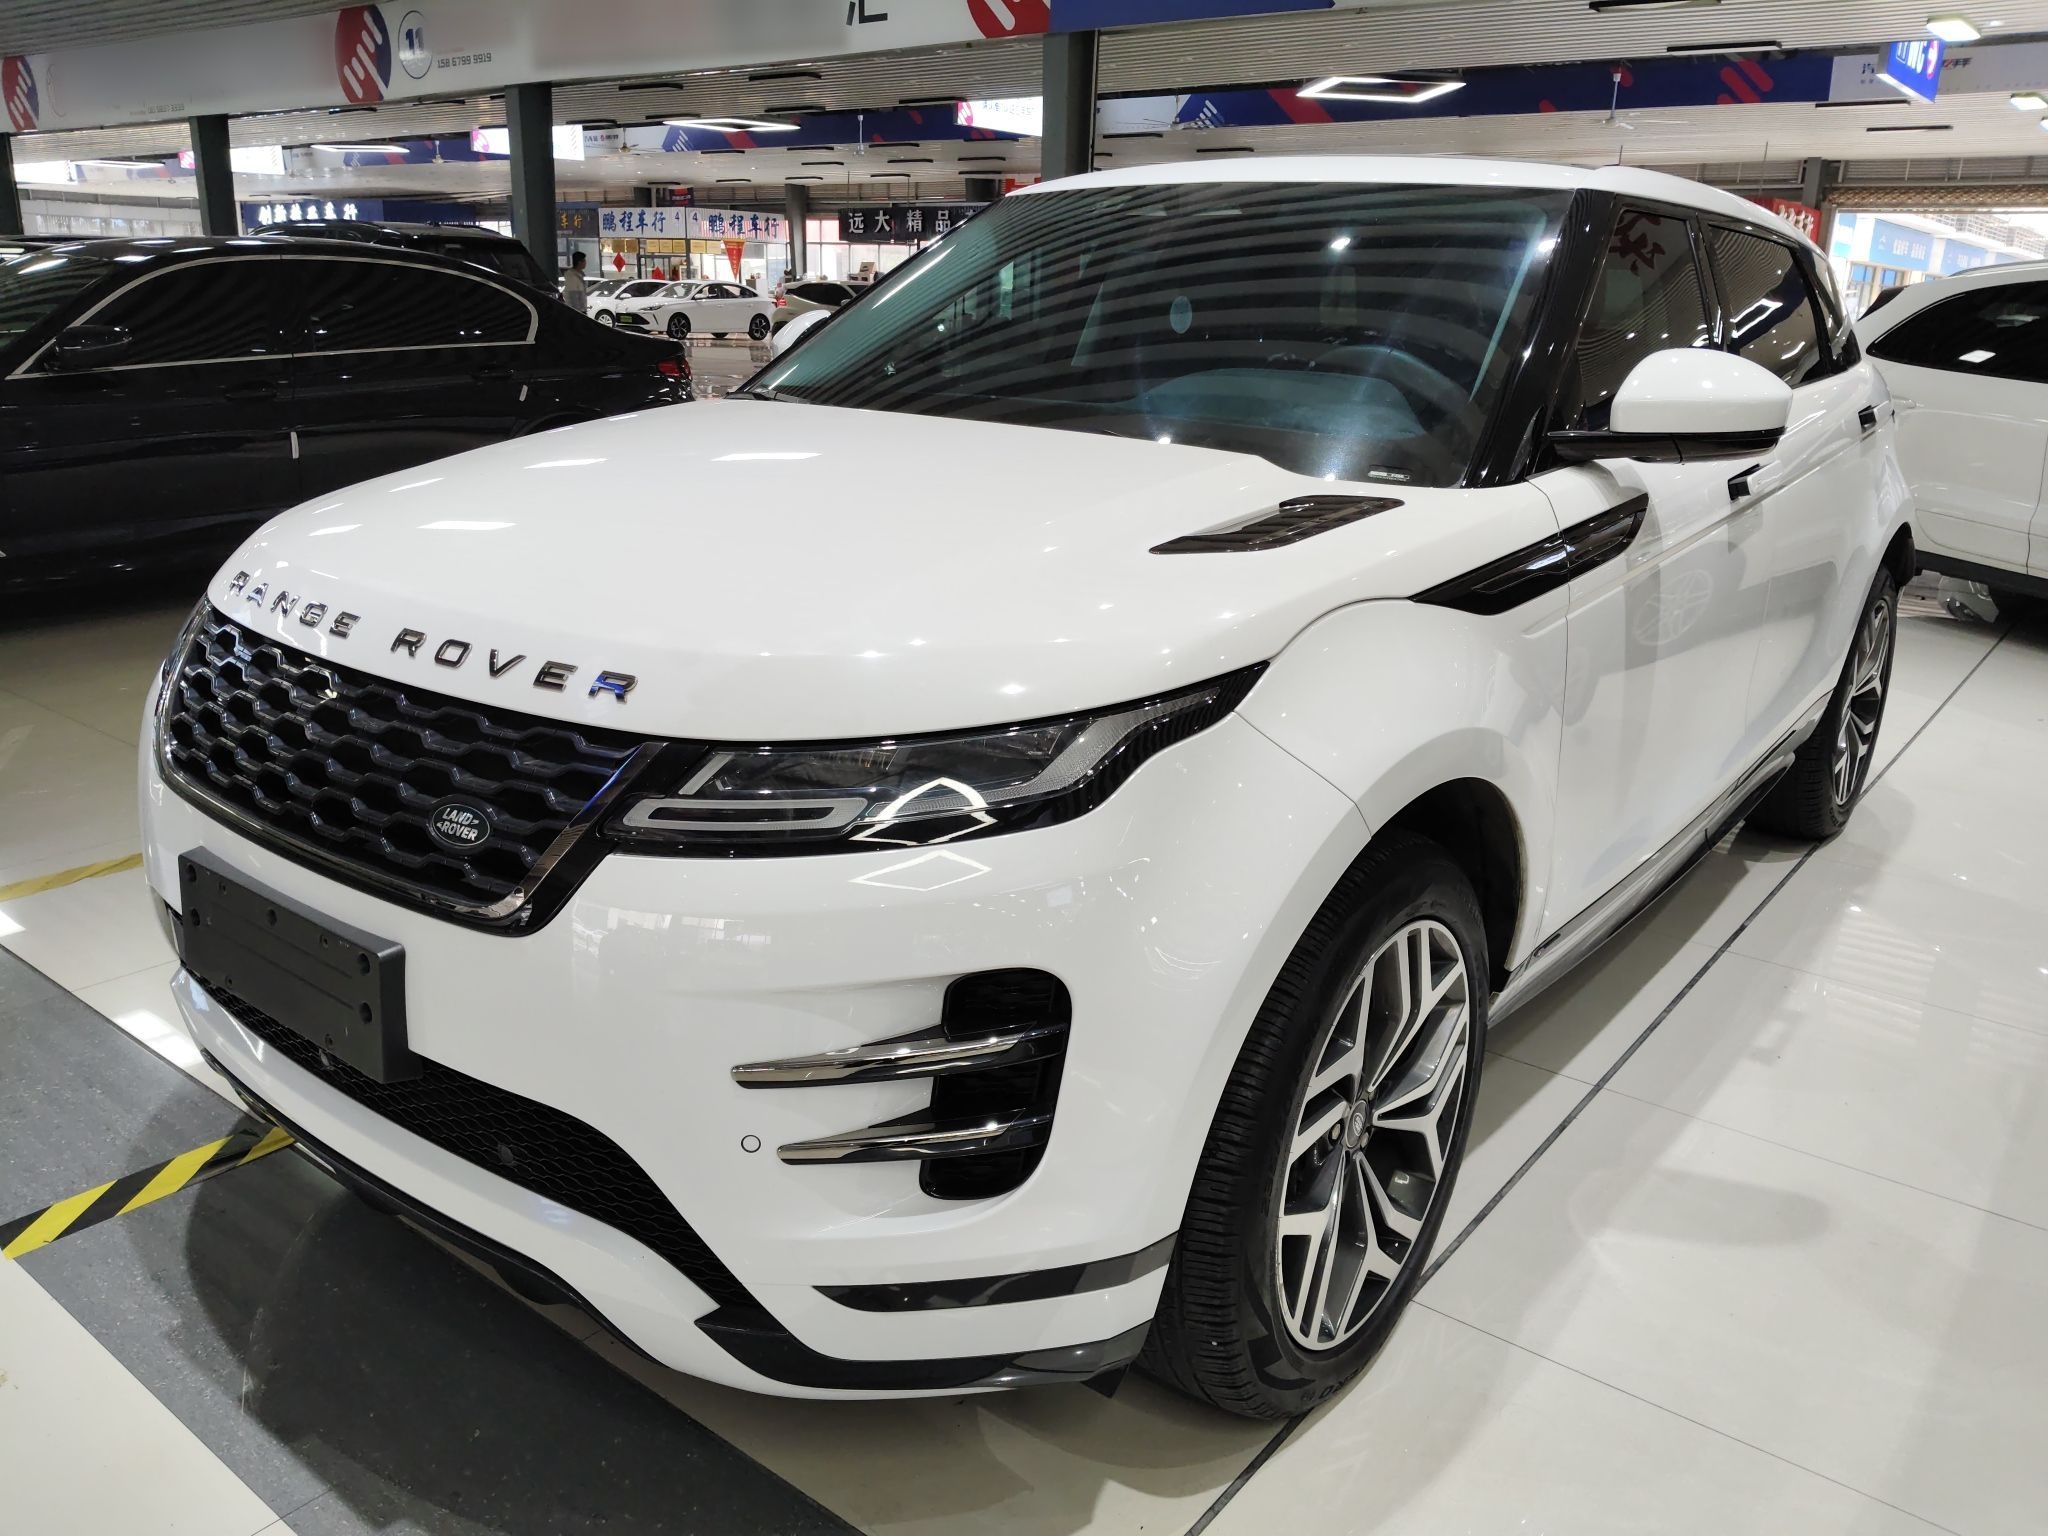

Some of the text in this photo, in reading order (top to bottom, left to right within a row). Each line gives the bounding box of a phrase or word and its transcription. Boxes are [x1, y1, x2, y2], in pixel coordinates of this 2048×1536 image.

[405, 27, 424, 52] 11
[437, 52, 492, 69] 158 6799 9919
[602, 209, 680, 235] 鹏程车行 4
[692, 211, 779, 239] 4 鹏程车行
[848, 209, 976, 234] 远大精品
[229, 570, 639, 704] RANGE ROVER
[442, 807, 474, 825] LAND
[441, 820, 479, 841] ROVER
